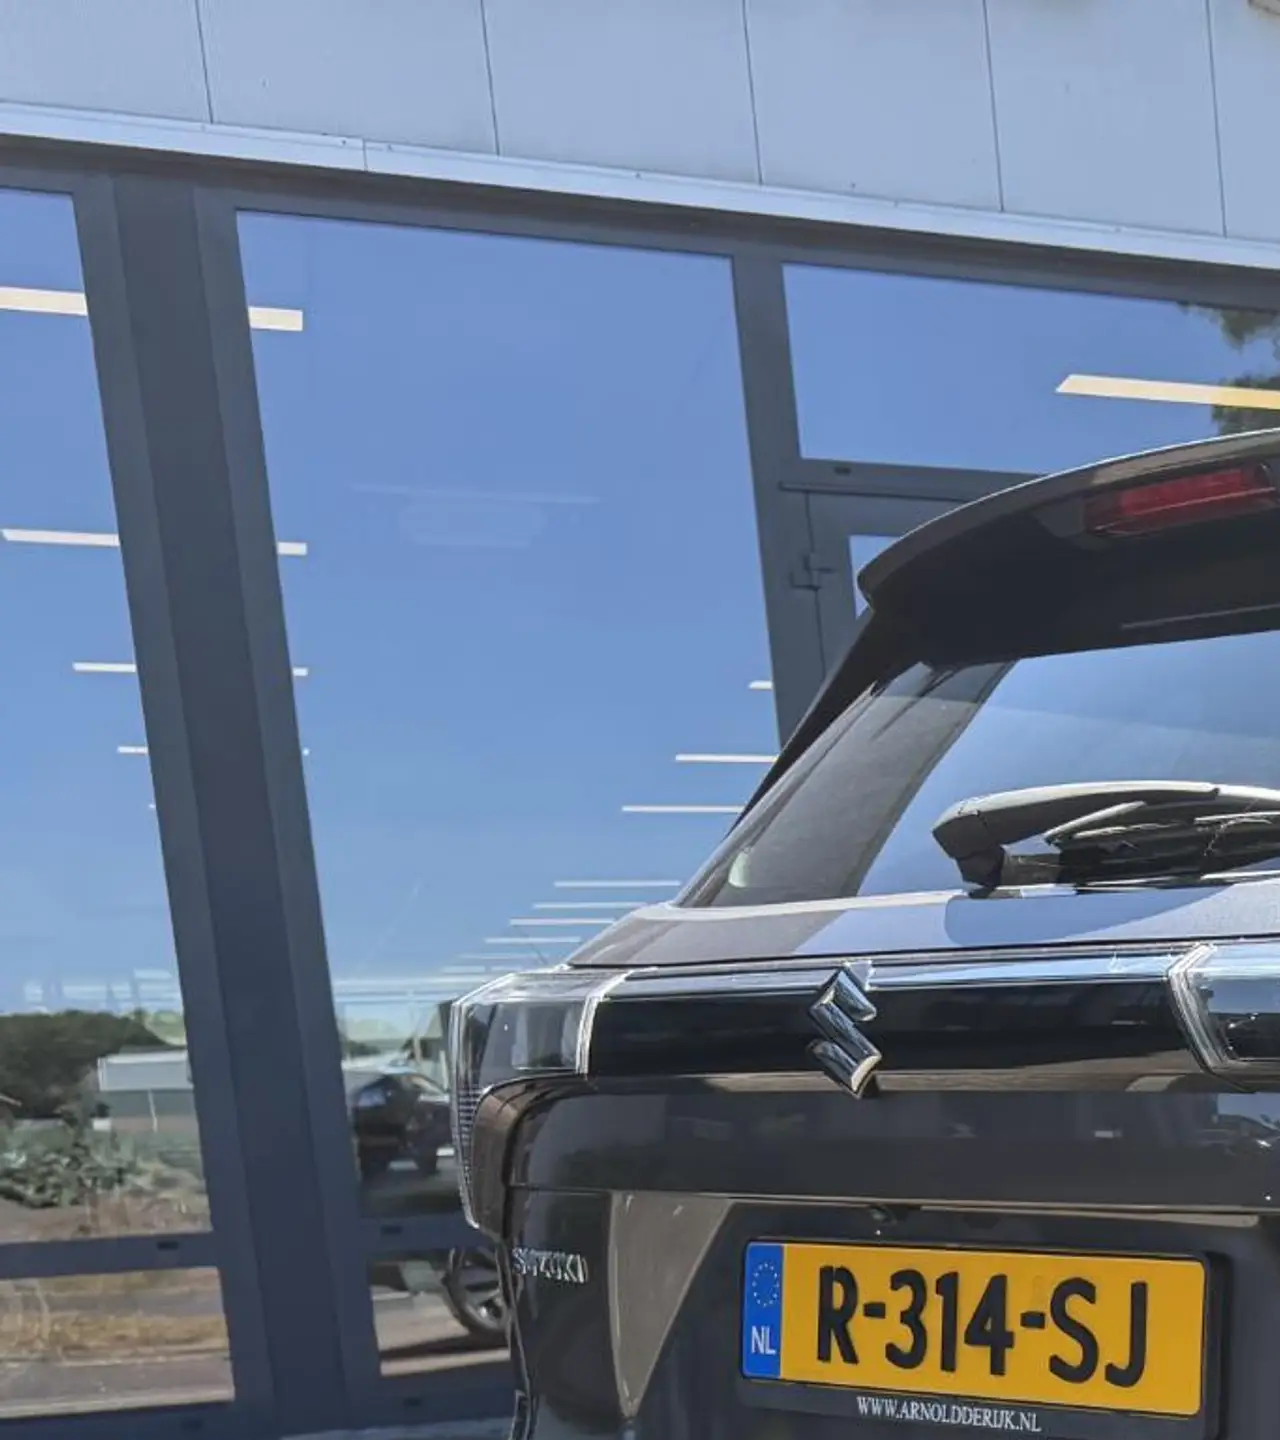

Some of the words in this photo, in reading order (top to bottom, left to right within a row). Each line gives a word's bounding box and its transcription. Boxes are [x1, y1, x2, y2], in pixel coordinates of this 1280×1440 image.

[751, 1325, 776, 1355] NL
[817, 1265, 1149, 1388] R-314-SJ
[856, 1396, 1042, 1432] WWW.ARNOLDDERIJK.NL
